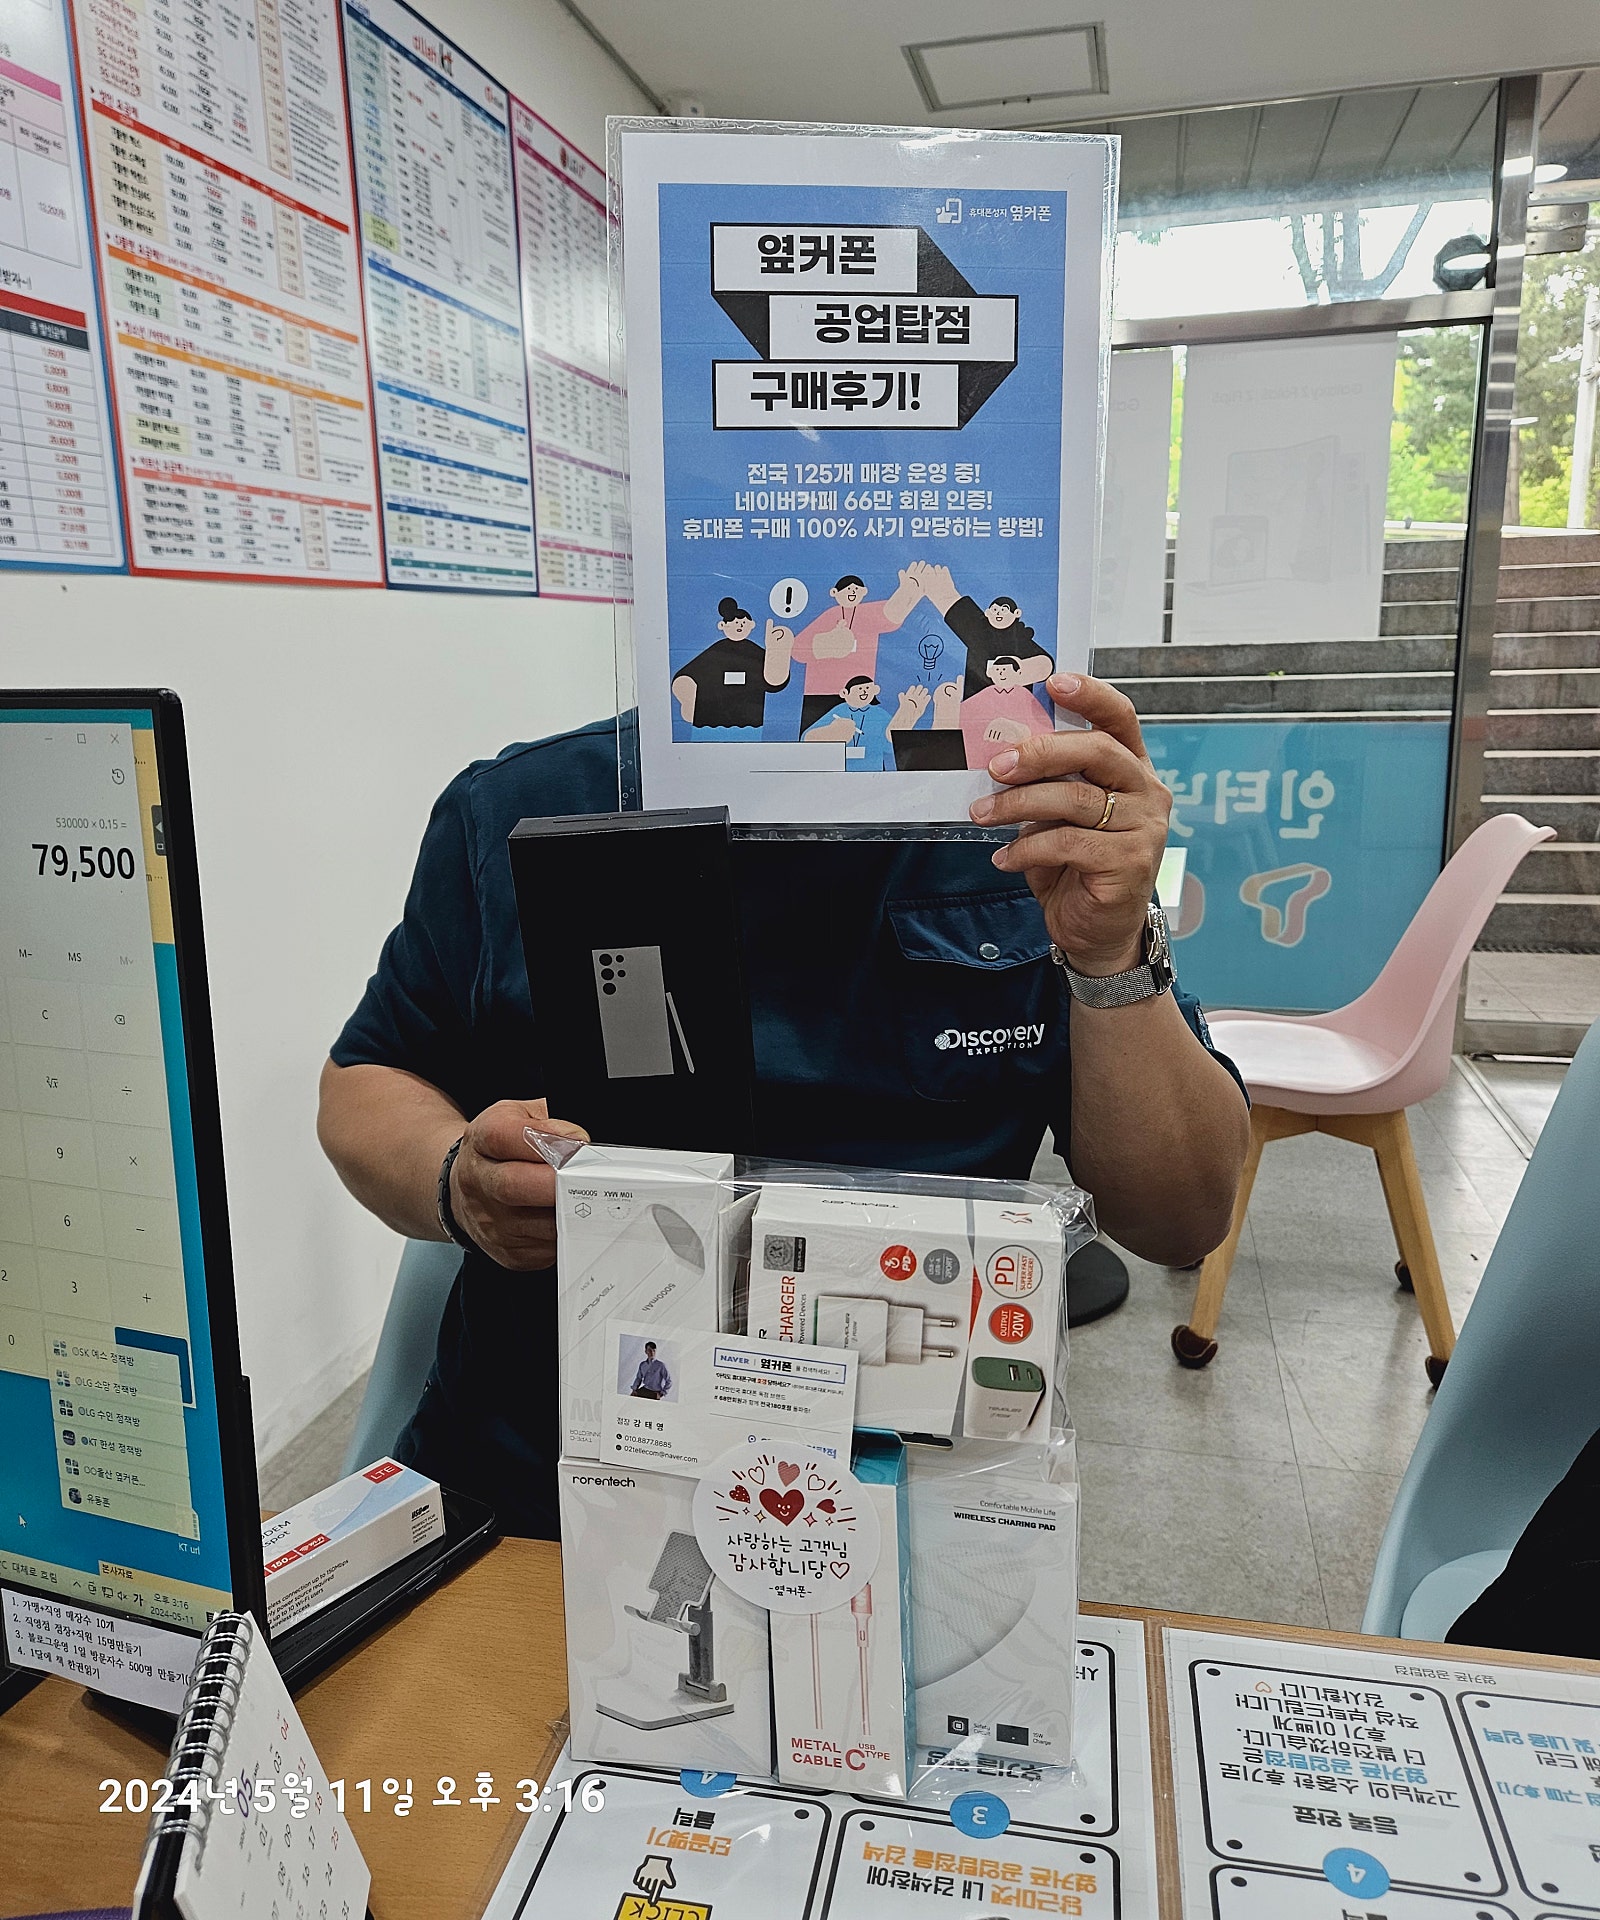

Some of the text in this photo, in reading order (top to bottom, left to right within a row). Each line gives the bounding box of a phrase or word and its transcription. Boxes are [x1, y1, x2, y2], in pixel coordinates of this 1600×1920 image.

[969, 205, 1051, 222] 휴대폰성지 옆커폰
[757, 234, 877, 275] 옆커폰
[814, 304, 970, 344] 공업탑점
[750, 371, 921, 411] 구매후기!
[748, 463, 981, 485] 전국 125개 매장 운영 중!
[735, 490, 993, 512] 네이버카페 66만 회원 인증!
[682, 518, 1044, 540] 휴대폰 구매 100% 사기 안당하는 방법!
[55, 817, 119, 830] 530000 0.15
[31, 843, 136, 883] 79,500
[68, 952, 82, 963] MS
[41, 1009, 49, 1020] C
[944, 1024, 1045, 1049] Discovery
[56, 1147, 64, 1159] 9
[567, 1188, 598, 1197] 5000mAh
[620, 1191, 634, 1199] 10W
[63, 1214, 71, 1227] 6
[902, 1255, 912, 1272] PD
[994, 1256, 1015, 1285] PD
[71, 1281, 78, 1293] 3
[642, 1283, 677, 1312] 5000mAh
[779, 1276, 796, 1343] CHARGER
[1000, 1311, 1008, 1337] OUTPUT
[1012, 1312, 1025, 1337] 20W
[720, 1354, 792, 1373] NAVER 옆커폰
[624, 1435, 672, 1449] 010.8877.8685
[371, 1466, 395, 1480] LTE
[572, 1476, 635, 1488] rorentech
[980, 1500, 1056, 1516] Comfortable Mobile Life
[953, 1511, 1056, 1531] WIRELESS CHARING PAD
[727, 1533, 847, 1558] 사랑하는 고객님
[102, 1563, 134, 1580] 본사자료
[728, 1553, 827, 1579] 감사합니당
[277, 1575, 335, 1613] power source required
[282, 1581, 311, 1602] connection
[172, 1598, 188, 1609] 3:16
[292, 1603, 311, 1616] access
[66, 1610, 92, 1626] 매장수
[96, 1617, 115, 1632] 10개
[150, 1606, 194, 1624] 2024-05-11
[28, 1633, 69, 1653] 블로그운영
[90, 1649, 125, 1668] 방문자수
[129, 1661, 153, 1677] 500명
[97, 1636, 143, 1657] 15명만들기
[68, 1659, 100, 1680] 한권읽기
[1395, 1664, 1496, 1686] 옆커폰 공업탑점
[1278, 1682, 1385, 1709] 감사합니다
[1235, 1692, 1419, 1730] 작성 부탁드립니다!
[280, 1718, 290, 1740] 04
[1272, 1714, 1386, 1743] 후기 이쁘게
[791, 1737, 842, 1753] METAL
[858, 1743, 875, 1751] USB
[1236, 1727, 1425, 1766] 더 발전하겠습니다.
[1482, 1728, 1595, 1754] 및 내용 입력
[273, 1751, 282, 1774] 03
[792, 1748, 866, 1771] CABLE C
[865, 1750, 891, 1761] TYPE
[1243, 1745, 1428, 1785] 옆커폰 공업탑점은
[1534, 1750, 1578, 1769] 드린
[1220, 1761, 1460, 1809] 고객님의 소중한 후기로
[1544, 1787, 1583, 1805] 구매
[672, 1807, 716, 1830] 클릭
[972, 1805, 989, 1825] 3
[1292, 1805, 1398, 1836] 등록 완료
[646, 1827, 732, 1857] 단골맺기
[862, 1842, 1097, 1894] 옆커폰 공업탑점을 검색
[1345, 1861, 1368, 1885] 4
[867, 1865, 1083, 1916] 당근마켓 내 검색창에
